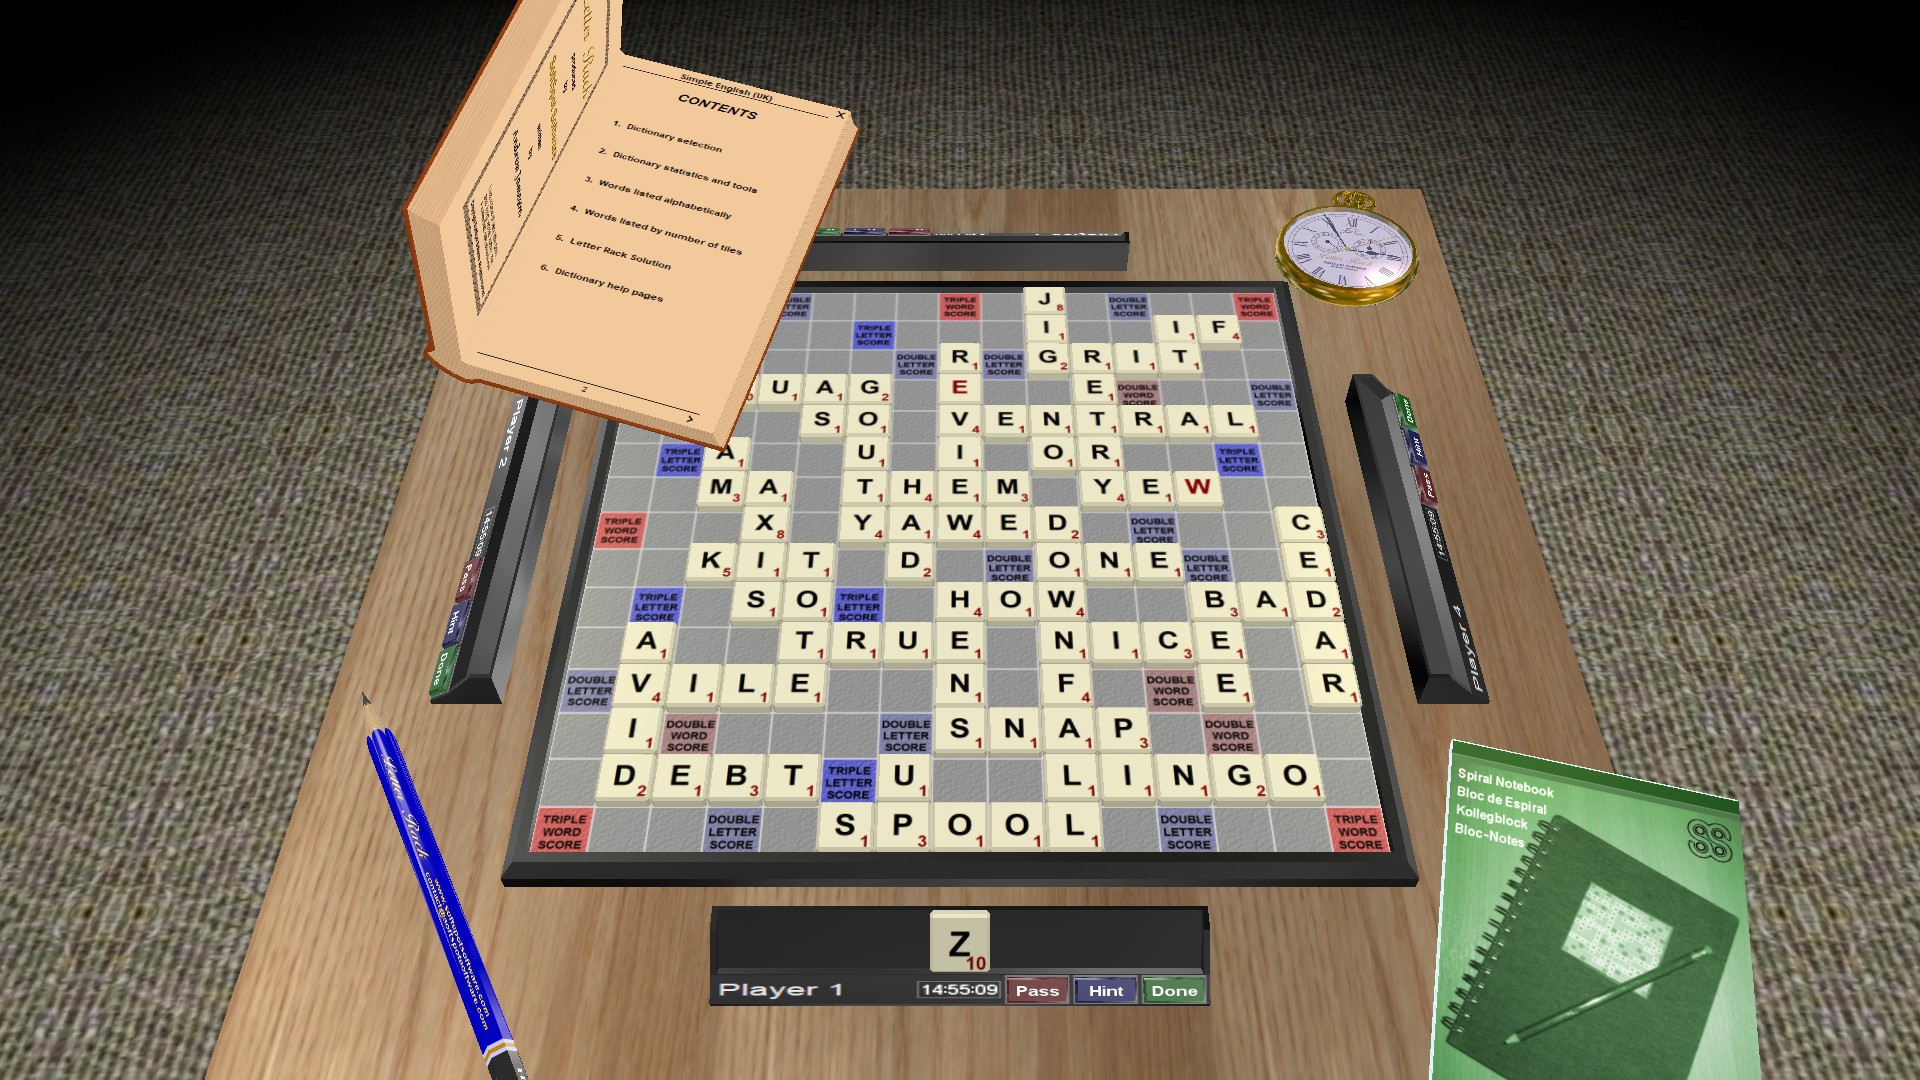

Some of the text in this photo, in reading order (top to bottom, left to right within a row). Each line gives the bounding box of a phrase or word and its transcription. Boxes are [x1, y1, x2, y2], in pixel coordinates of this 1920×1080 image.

[681, 74, 773, 103] Simple English (UK)
[678, 94, 758, 120] CONTENTS
[627, 123, 675, 143] Dictionary
[677, 136, 722, 153] selection
[613, 151, 661, 170] Dictionary
[664, 164, 709, 181] statistics
[711, 176, 730, 187] and
[732, 182, 758, 194] tools
[599, 179, 631, 194] Words
[633, 188, 663, 202] listed
[663, 197, 732, 220] alphabetically
[584, 208, 617, 222] Words
[619, 217, 649, 231] listed
[650, 225, 663, 235] by
[664, 230, 706, 246] number
[707, 241, 719, 249] of
[720, 244, 743, 256] tiles
[570, 237, 602, 252] Letter
[603, 246, 628, 259] Rack
[630, 253, 672, 271] Solution
[555, 266, 605, 287] Dictionary
[607, 281, 630, 294] help
[631, 288, 664, 303] pages
[1257, 399, 1292, 407] SCORE
[498, 398, 524, 469] Player 2
[665, 448, 701, 456] TRIPLE
[1220, 448, 1255, 456] TRIPLE
[661, 456, 701, 464] LETTER
[1219, 456, 1259, 464] LETTER
[1222, 465, 1258, 473] SCORE
[605, 517, 642, 526] TRIPLE
[1130, 517, 1174, 526] DOUBLE
[604, 527, 638, 535] WORD
[1133, 527, 1174, 535] LETTER
[601, 536, 638, 544] SCORE
[1136, 536, 1174, 544] SCORE
[987, 554, 1032, 563] DOUBLE
[1183, 554, 1229, 563] DOUBLE
[988, 564, 1031, 572] LETTER
[1186, 564, 1229, 572] LETTER
[991, 574, 1029, 582] SCORE
[1190, 574, 1228, 582] SCORE
[639, 593, 678, 602] TRIPLE
[840, 593, 879, 601] TRIPLE
[634, 603, 678, 612] LETTER
[837, 603, 880, 612] LETTER
[635, 613, 674, 622] SCORE
[838, 613, 877, 622] SCORE
[1452, 604, 1484, 693] Player 4
[433, 652, 449, 686] Done
[567, 676, 616, 685] DOUBLE
[1146, 675, 1194, 685] DOUBLE
[567, 686, 613, 695] LETTER
[1153, 686, 1190, 695] WORD
[567, 697, 609, 706] SCORE
[1153, 697, 1193, 706] SCORE
[666, 720, 715, 729] DOUBLE
[881, 720, 931, 729] DOUBLE
[1204, 720, 1254, 729] DOUBLE
[671, 731, 708, 740] WORD
[883, 731, 929, 740] LETTER
[1212, 731, 1250, 740] WORD
[667, 743, 709, 752] SCORE
[885, 743, 927, 752] SCORE
[1212, 743, 1254, 752] SCORE
[829, 766, 871, 776] TRIPLE
[825, 778, 873, 788] LETTER
[1457, 767, 1555, 799] Spiral Notebook
[827, 790, 870, 800] SCORE
[1456, 785, 1547, 815] Bloc de Espiral
[381, 754, 430, 860] Letter Rack
[544, 814, 587, 824] TRIPLE
[708, 814, 760, 825] DOUBLE
[1160, 814, 1212, 824] DOUBLE
[1333, 814, 1378, 824] TRIPLE
[1456, 804, 1529, 831] Kollegblock
[543, 827, 582, 837] WORD
[708, 827, 757, 837] LETTER
[1163, 827, 1212, 837] LETTER
[1338, 827, 1378, 837] WORD
[1454, 822, 1525, 848] Bloc-Notes
[537, 840, 582, 850] SCORE
[709, 840, 753, 850] SCORE
[1167, 840, 1211, 850] SCORE
[1339, 840, 1383, 850] SCORE
[949, 931, 971, 958] Z
[718, 981, 843, 1000] Player 1
[921, 982, 999, 997] 14:55:09
[1015, 983, 1060, 998] Pass
[1088, 982, 1124, 998] Hint
[1151, 982, 1198, 998] Done
